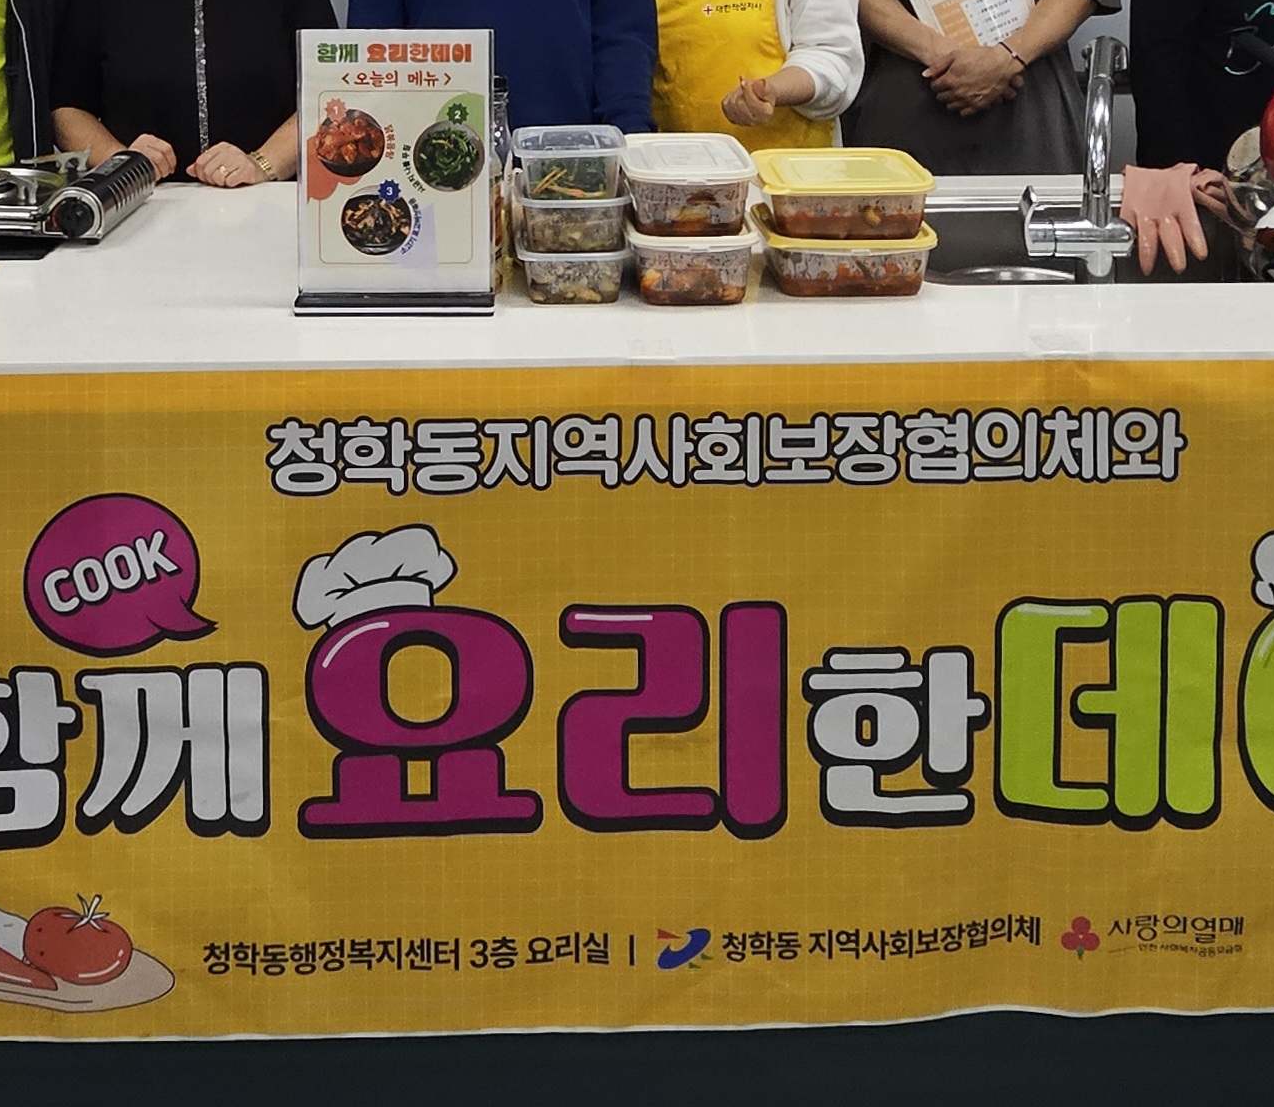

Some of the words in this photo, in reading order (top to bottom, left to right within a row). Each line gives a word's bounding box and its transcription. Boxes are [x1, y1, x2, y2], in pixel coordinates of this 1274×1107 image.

[317, 43, 359, 63] 함께
[366, 43, 472, 64] 요리한데이
[266, 407, 1188, 496] 청학동지역사회보장협의체와
[41, 528, 181, 616] COOK
[721, 930, 802, 962] 청학동
[807, 914, 1041, 960] 지역사회보장협의체
[1108, 914, 1244, 944] 사랑의열매
[203, 937, 460, 975] 청학동행정복지센터
[469, 936, 518, 970] 3층
[525, 932, 610, 965] 요리실
